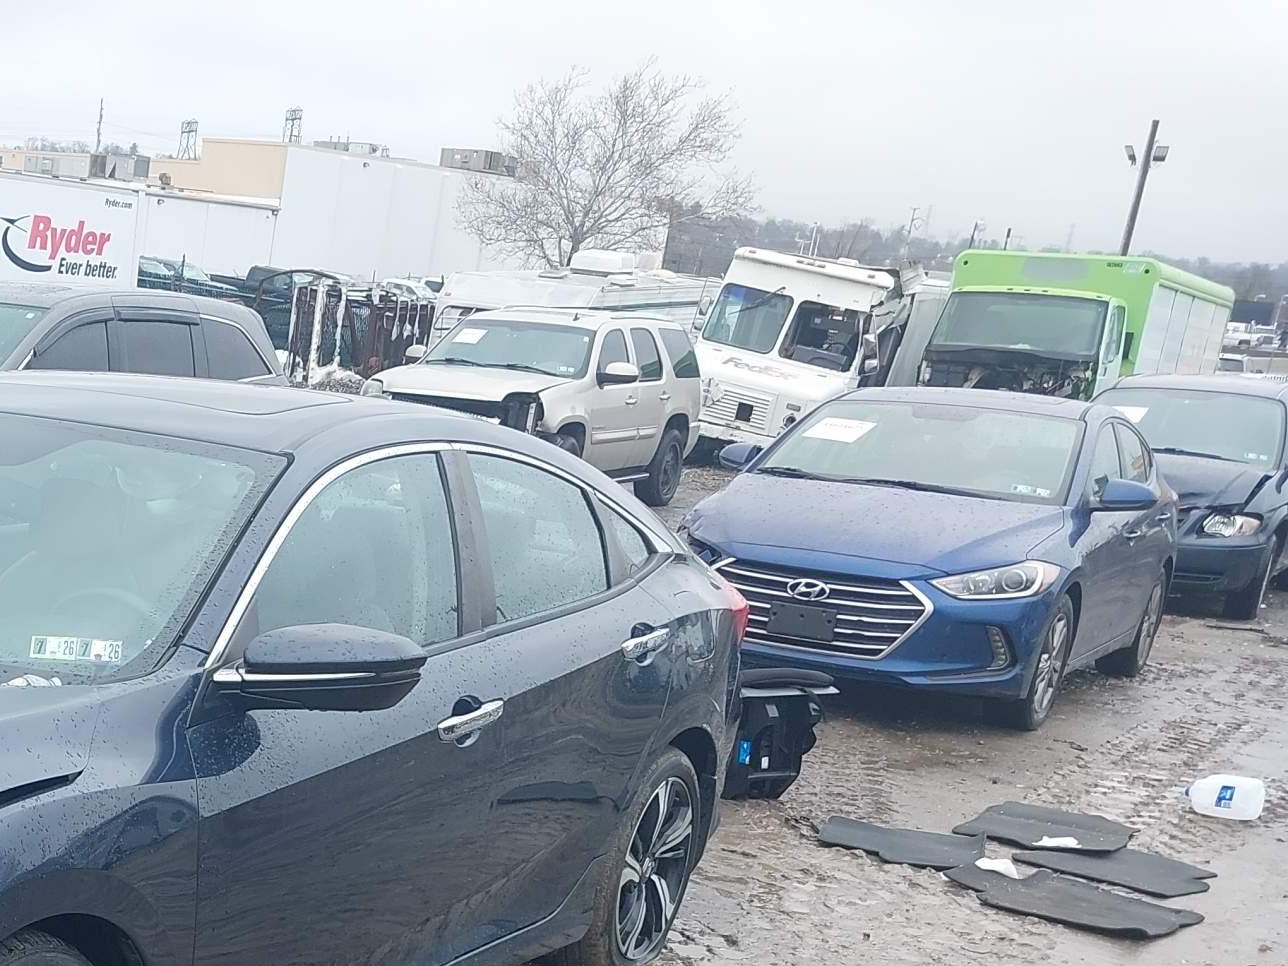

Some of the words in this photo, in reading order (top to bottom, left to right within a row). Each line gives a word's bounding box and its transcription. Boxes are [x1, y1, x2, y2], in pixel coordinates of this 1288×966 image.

[104, 198, 133, 209] Ryder.com
[27, 214, 112, 260] Ryder
[57, 257, 83, 276] Ever
[84, 259, 118, 279] better.
[63, 640, 74, 655] 26
[108, 643, 120, 659] 26
